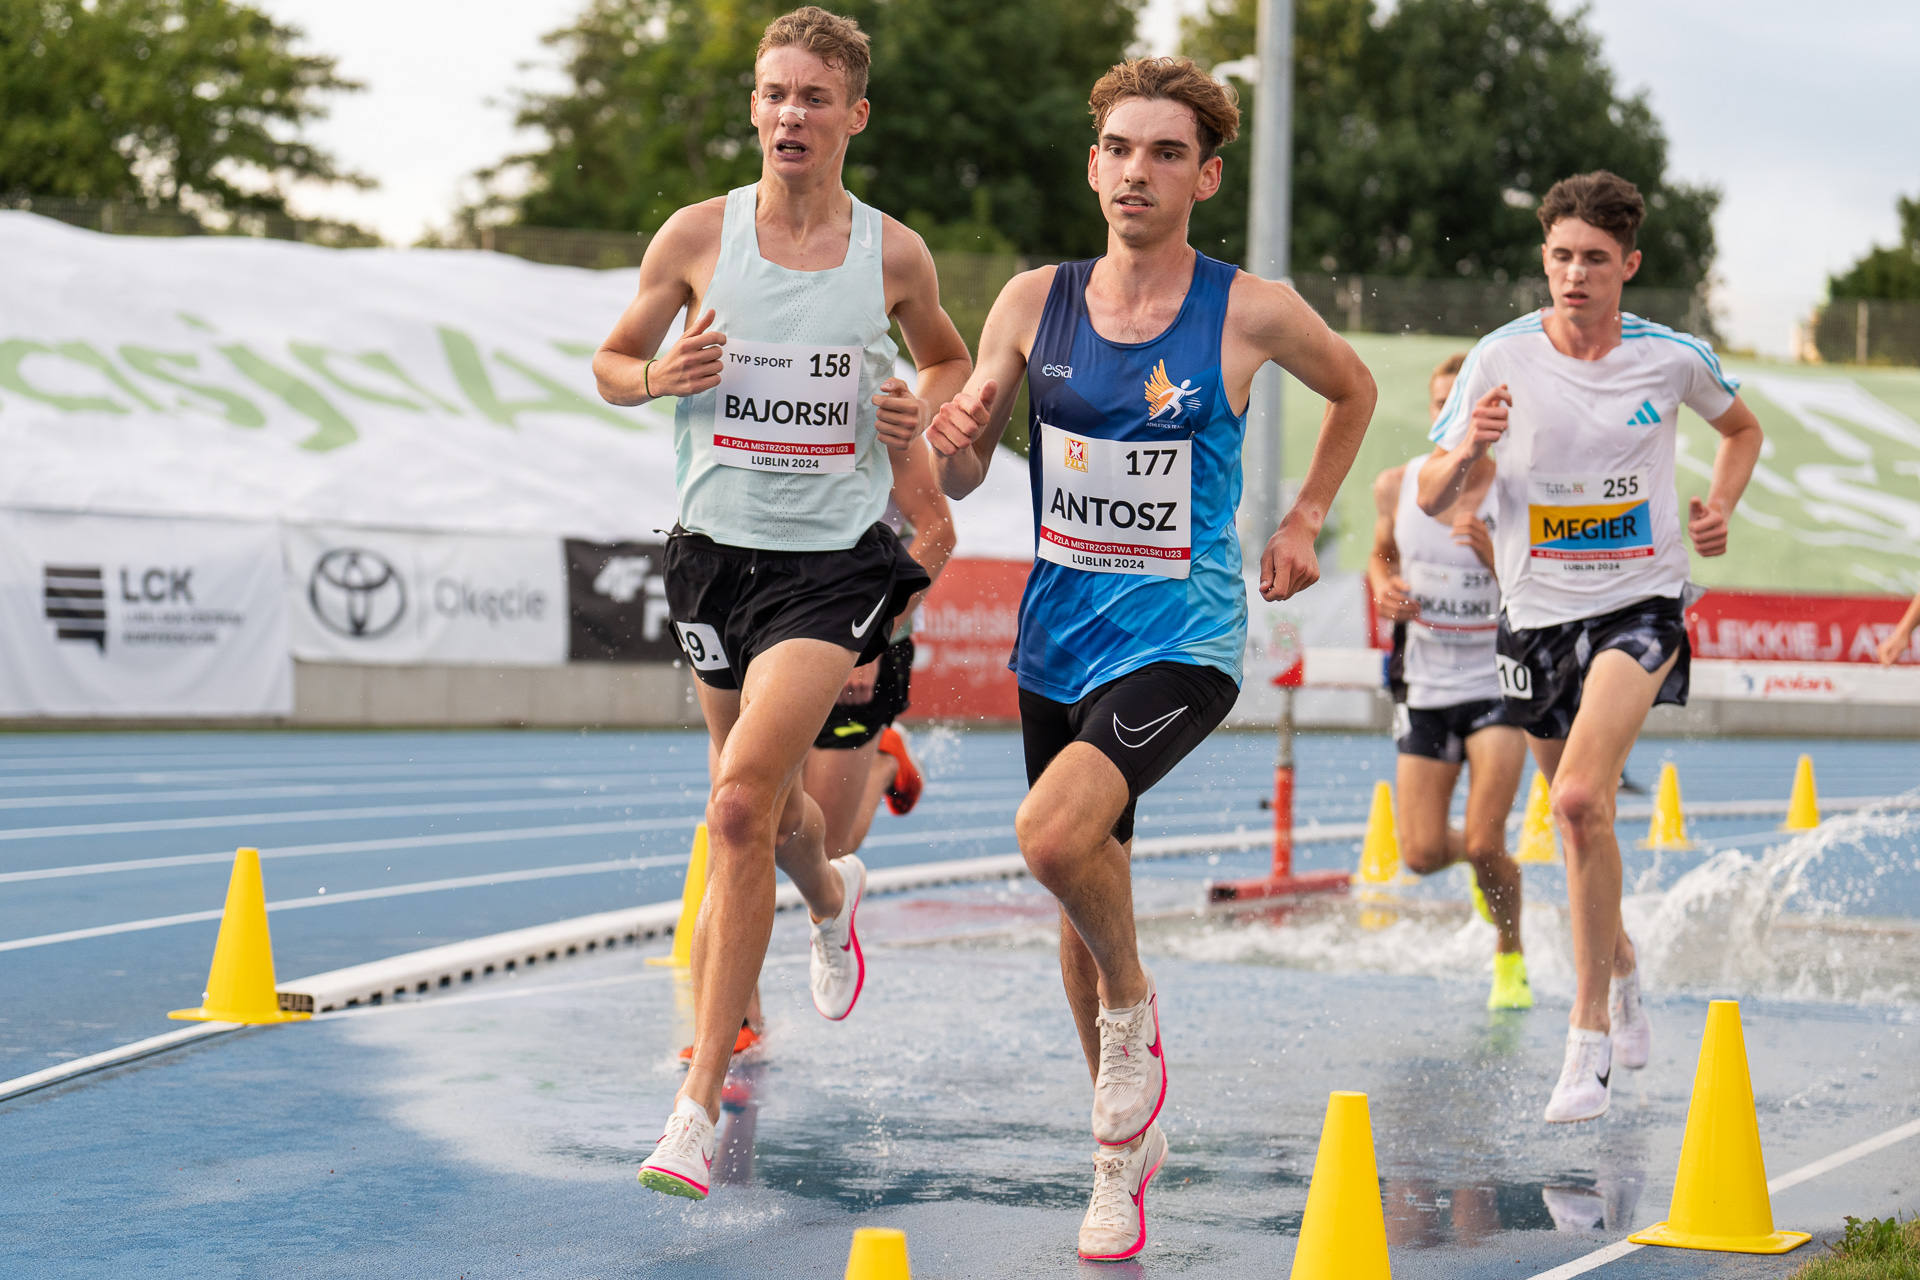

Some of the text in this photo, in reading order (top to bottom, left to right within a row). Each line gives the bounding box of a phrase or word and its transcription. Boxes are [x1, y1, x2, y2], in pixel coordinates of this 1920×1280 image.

[729, 353, 793, 369] TVP SPORT
[809, 353, 851, 378] 158
[724, 393, 849, 427] BAJORSKI
[720, 438, 849, 454] 41. PZLA MISTRZOSTWA POLSKI U23
[751, 455, 820, 469] LUBLIN 2024
[1065, 457, 1087, 471] PZLA
[1125, 449, 1178, 476] 177
[1603, 475, 1639, 498] 255
[1050, 487, 1178, 532] ANTOSZ
[1542, 515, 1638, 540] MEGIER
[1046, 531, 1182, 558] 41. PZLA MISTRZOSTWA POLSKI U23
[1072, 553, 1145, 570] LUBLIN 2024
[1563, 562, 1621, 571] LUBLIN 2024
[119, 568, 195, 605] LCK
[685, 630, 719, 663] 9.
[1696, 618, 1843, 661] LEKKIEJ
[1499, 663, 1527, 691] 10
